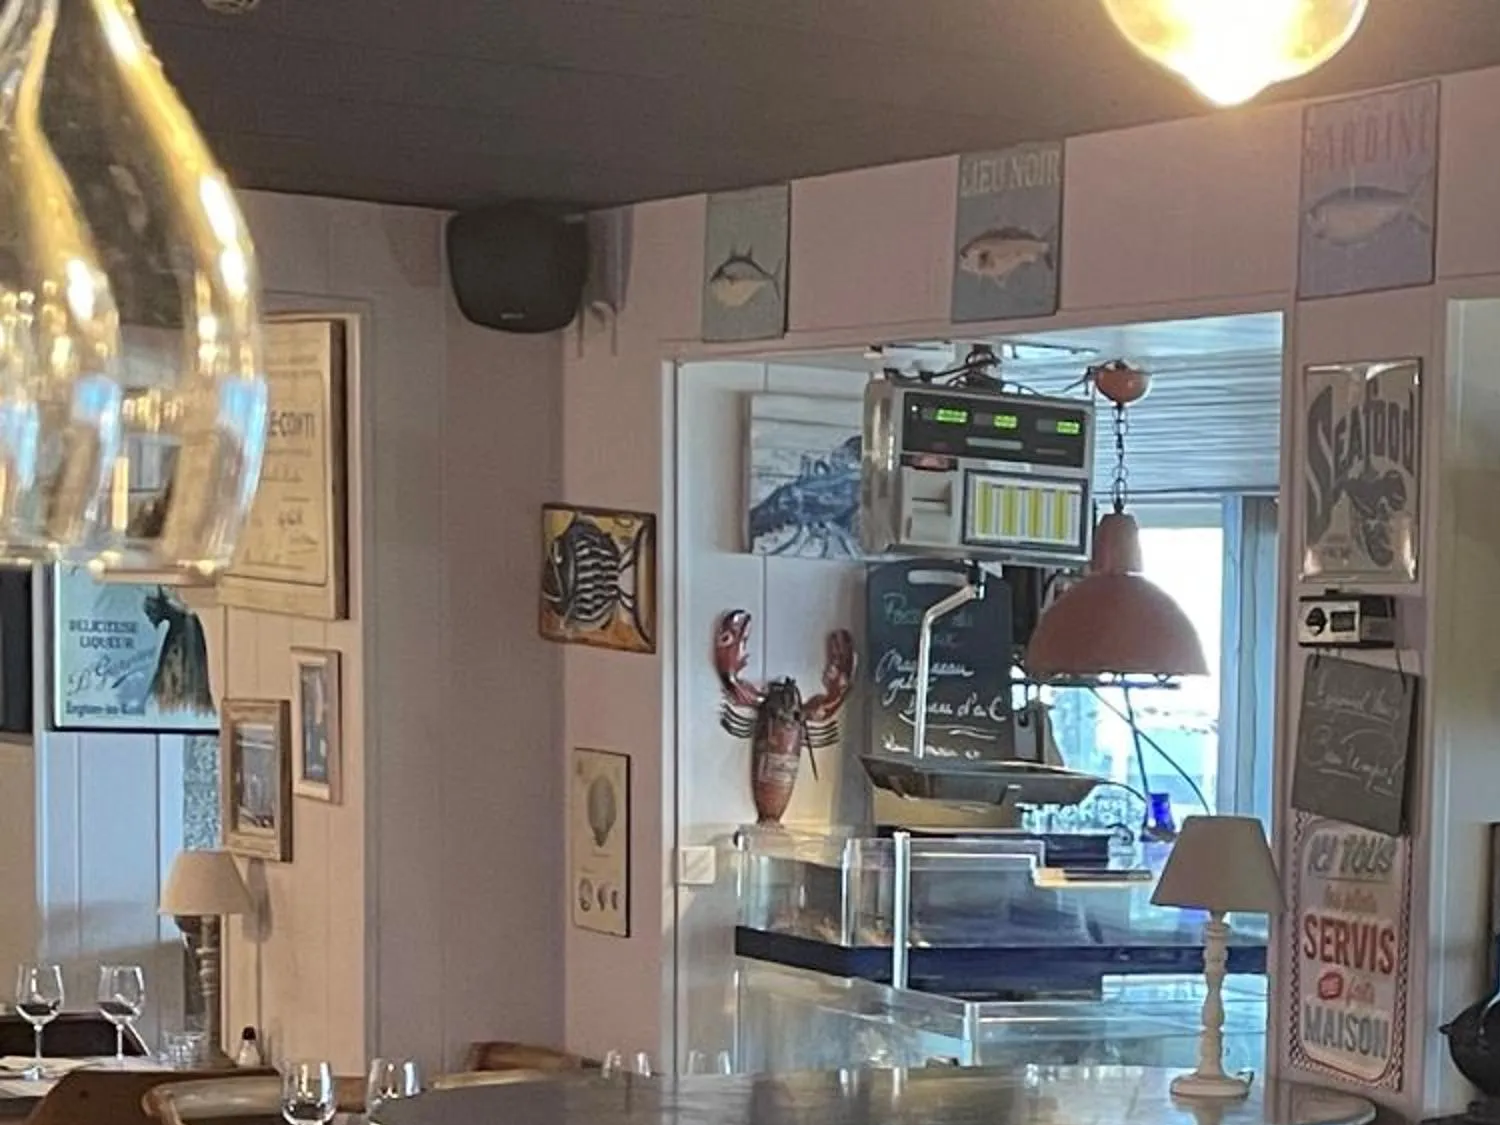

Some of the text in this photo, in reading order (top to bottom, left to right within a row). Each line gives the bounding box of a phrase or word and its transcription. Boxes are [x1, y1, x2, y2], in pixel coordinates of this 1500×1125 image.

[1340, 833, 1396, 876] TOUS
[1304, 914, 1395, 976] SERVIS
[1303, 1004, 1389, 1059] MAISON
